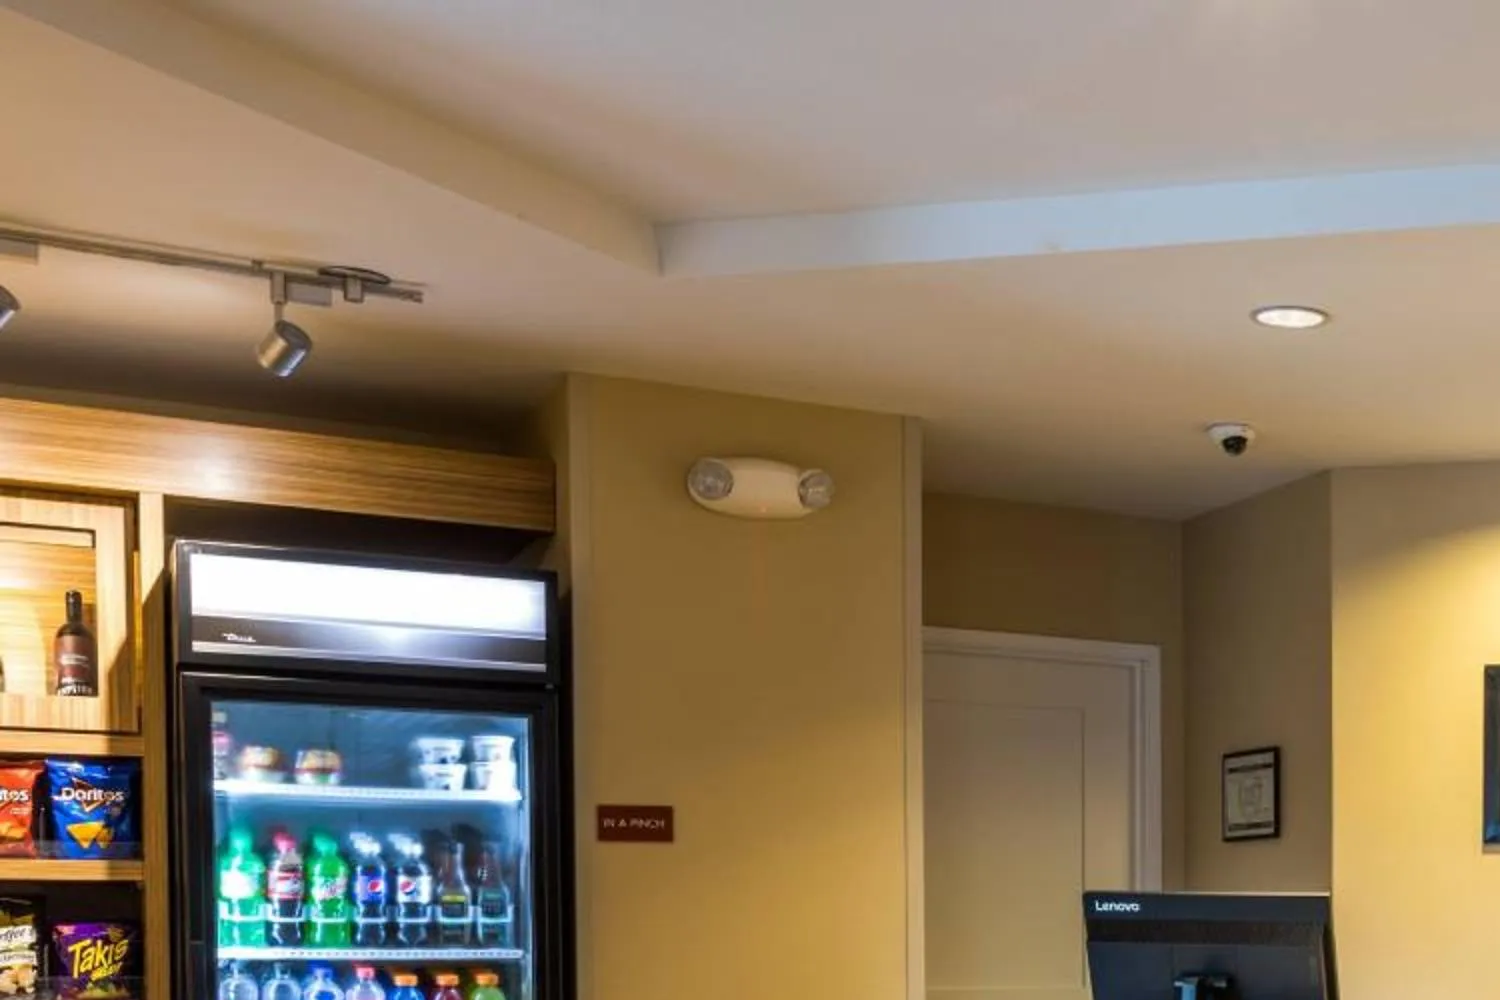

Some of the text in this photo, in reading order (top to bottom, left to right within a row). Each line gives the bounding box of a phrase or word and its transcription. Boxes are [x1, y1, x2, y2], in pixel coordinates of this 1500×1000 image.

[61, 786, 124, 801] Doritos
[1095, 900, 1140, 912] Lenovo
[67, 939, 129, 980] Takis
